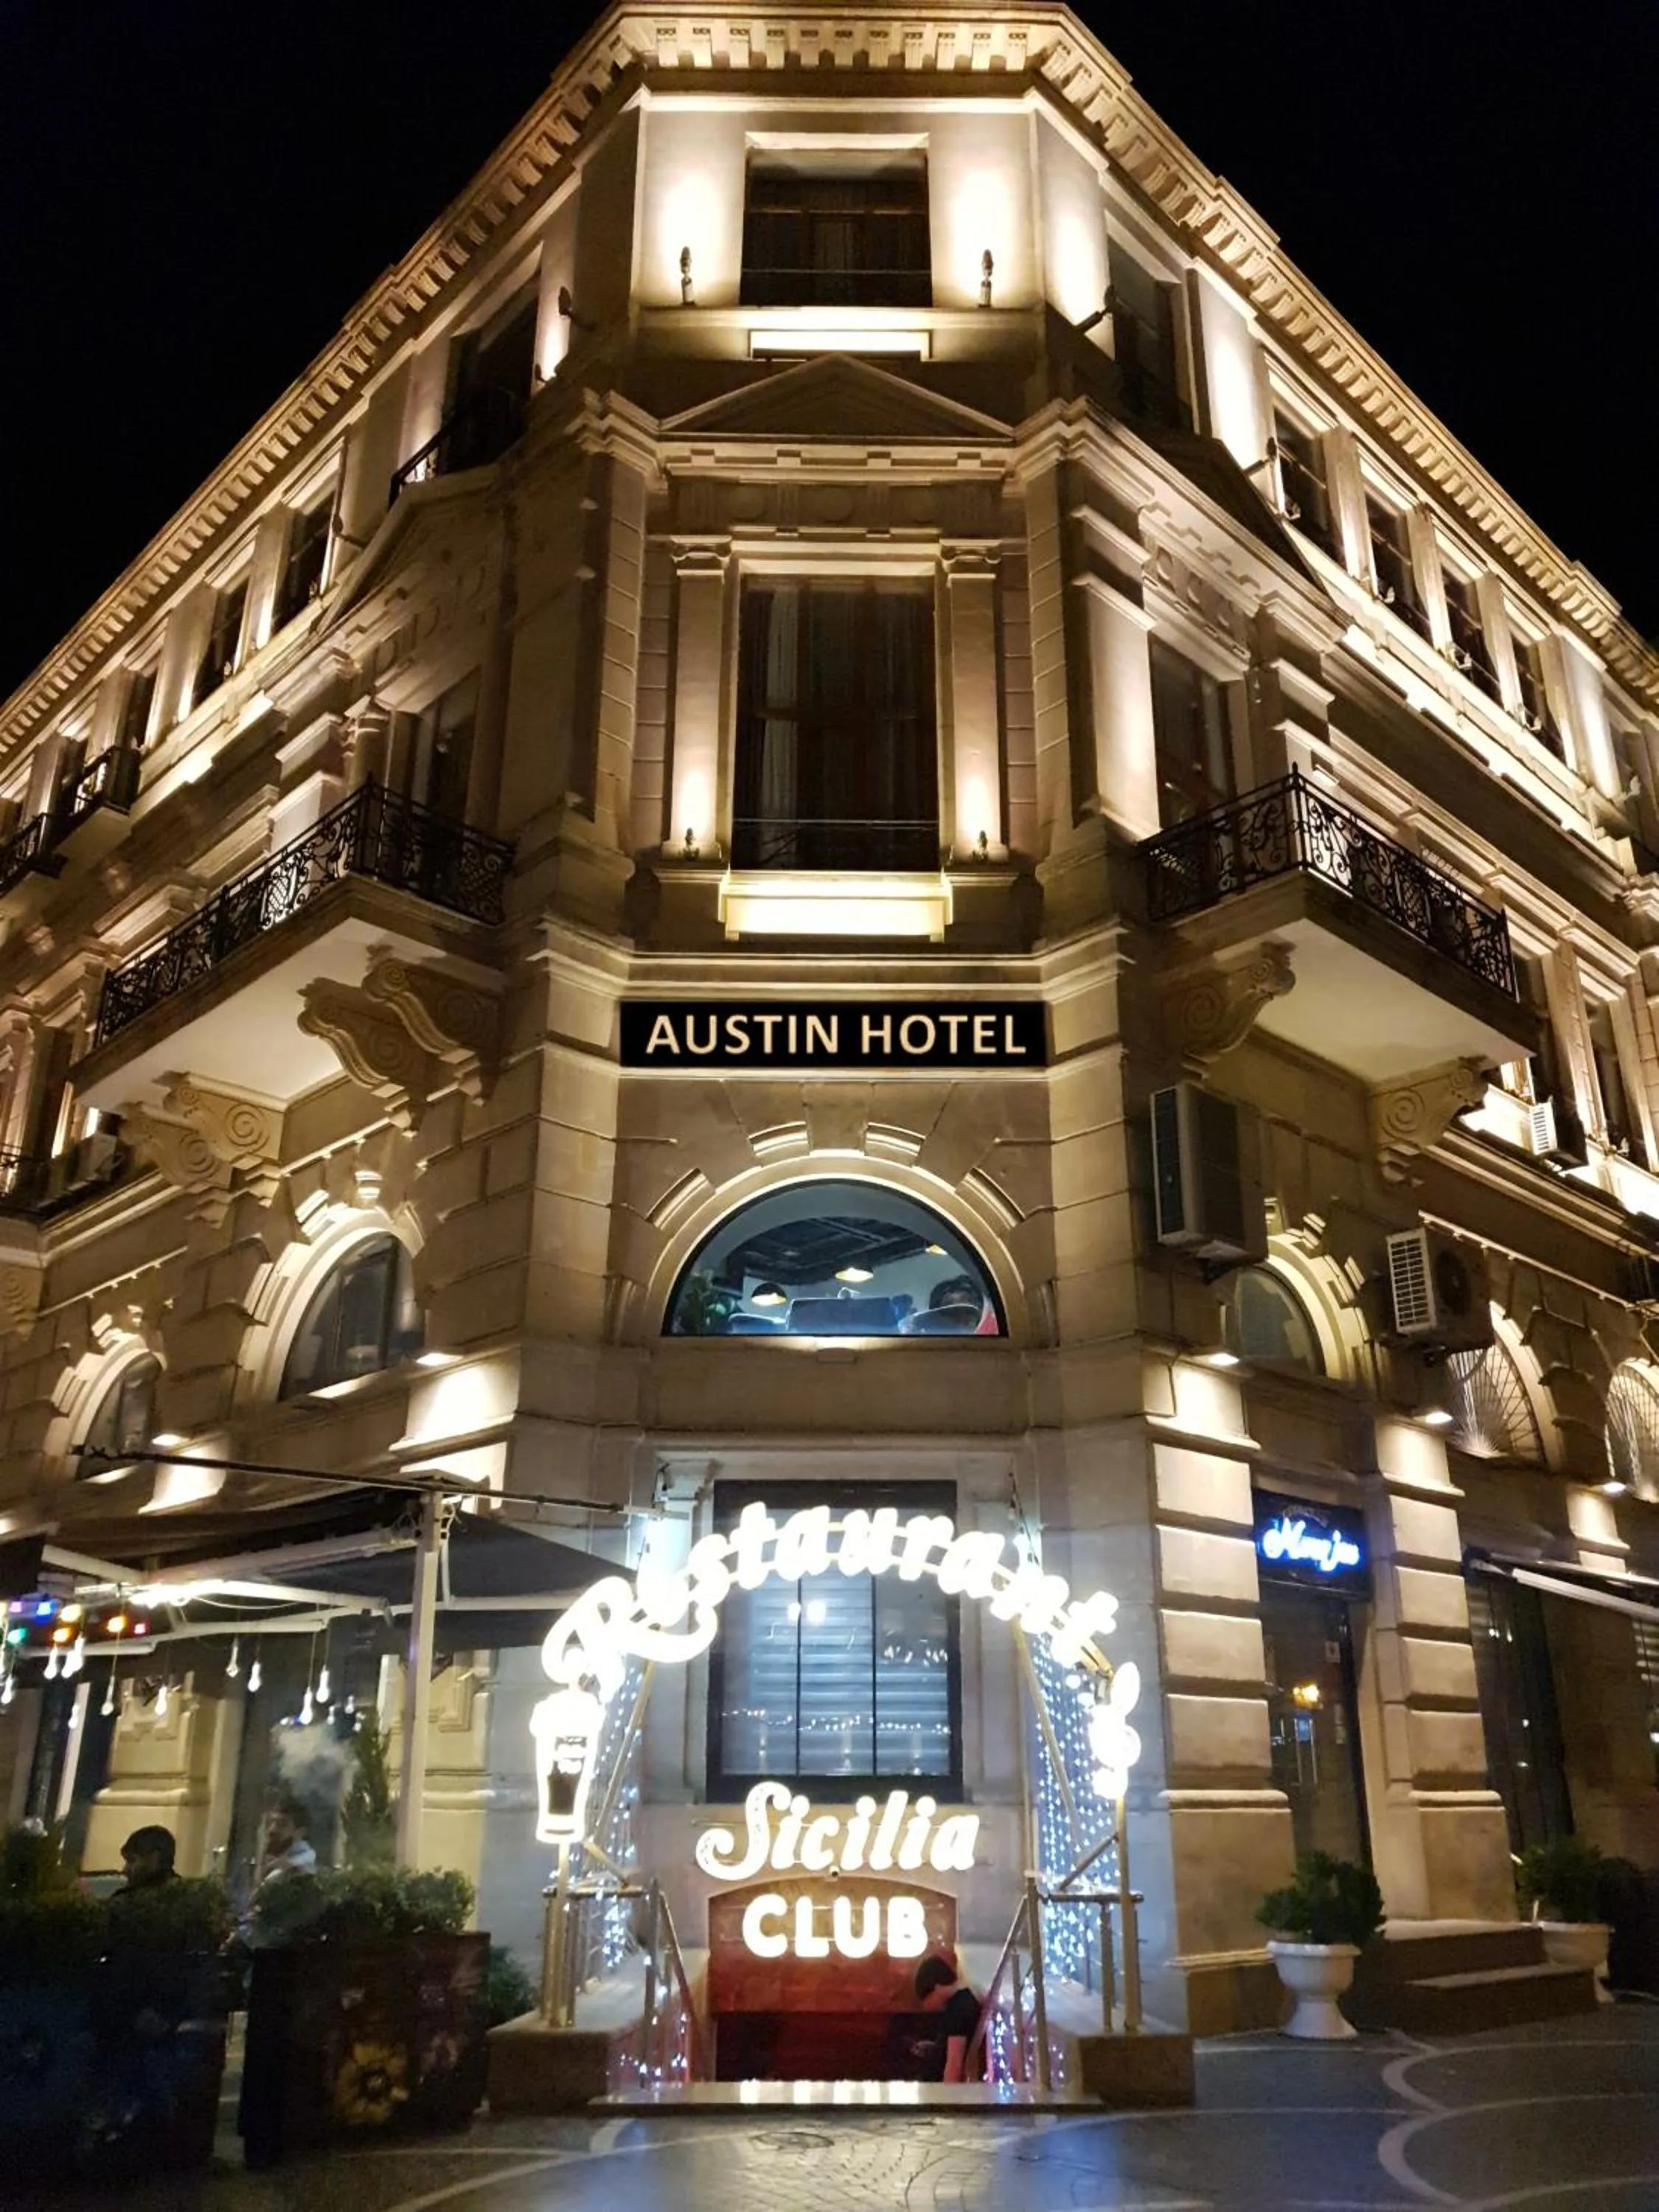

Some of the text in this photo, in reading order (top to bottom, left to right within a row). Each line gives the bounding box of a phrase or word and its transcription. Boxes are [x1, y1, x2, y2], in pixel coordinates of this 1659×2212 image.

[645, 1014, 1028, 1055] AUSTIN HOTEL
[540, 1501, 1119, 1705] Restaurant
[695, 1781, 980, 1881] Sicilia
[742, 1893, 929, 1958] CLUB
